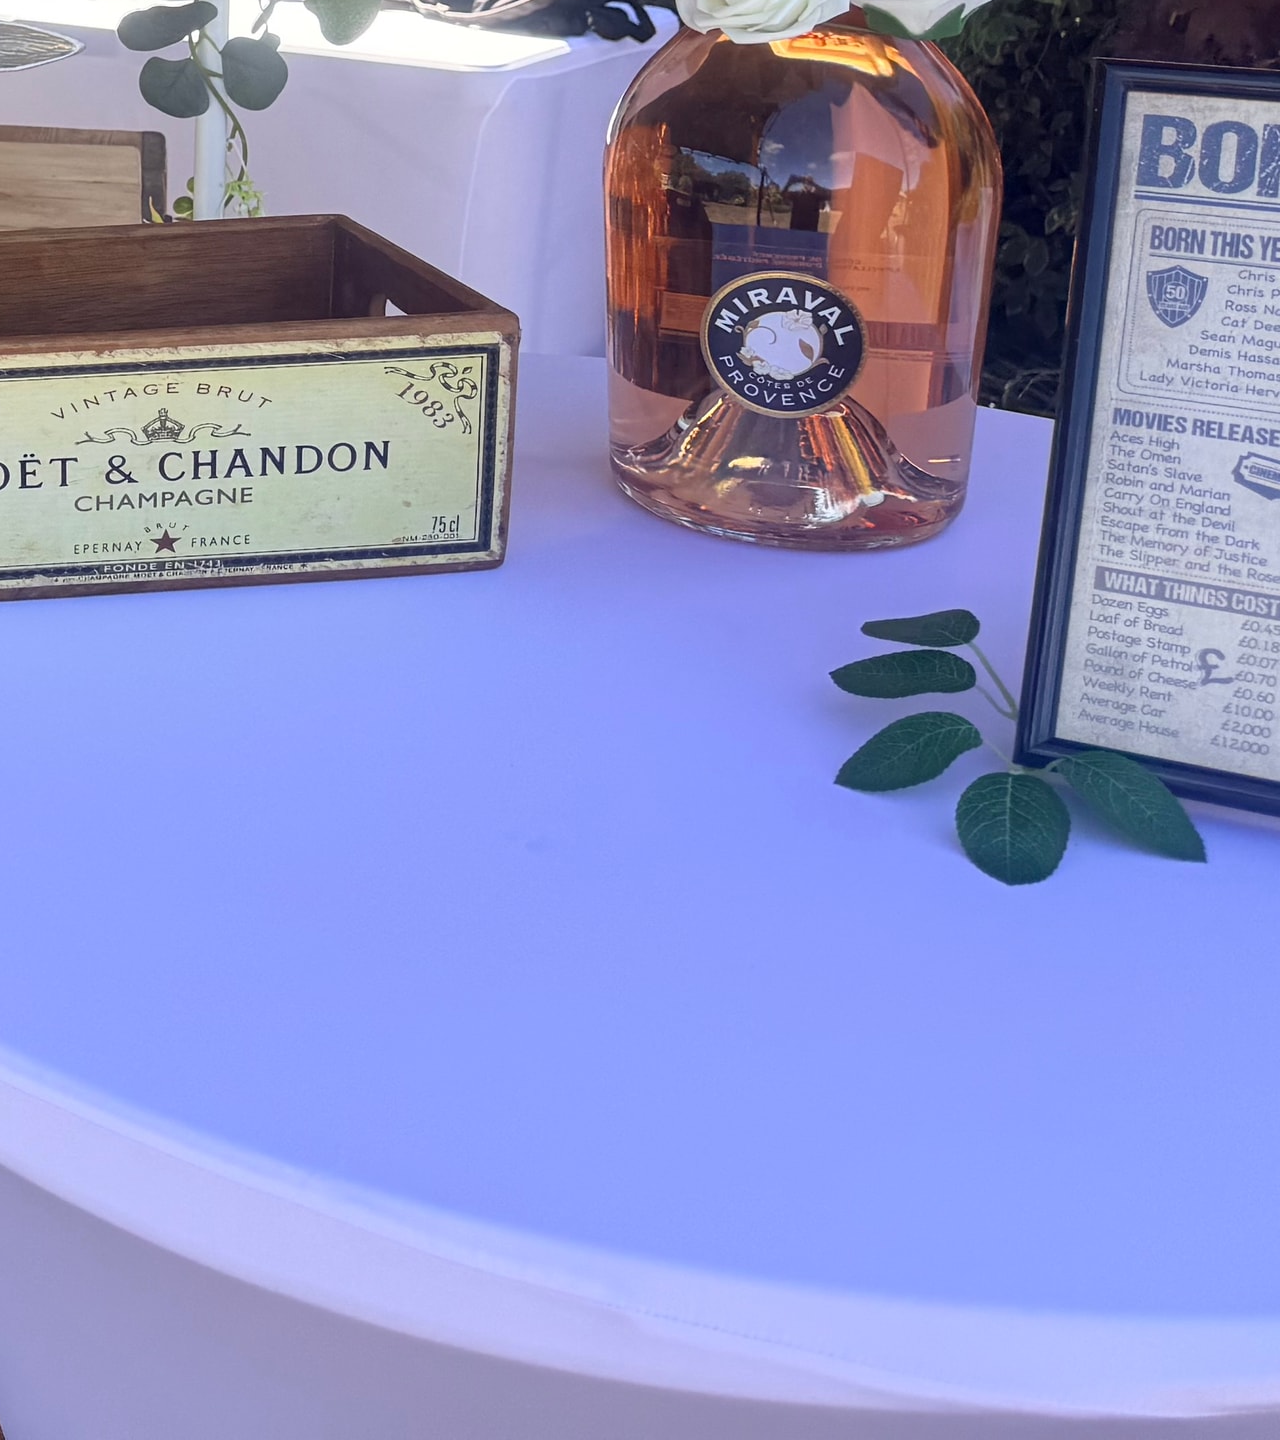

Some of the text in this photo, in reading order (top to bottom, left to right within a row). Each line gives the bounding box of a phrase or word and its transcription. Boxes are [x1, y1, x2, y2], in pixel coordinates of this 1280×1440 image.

[1149, 224, 1207, 256] BORN
[1209, 230, 1255, 260] THIS
[1238, 269, 1276, 283] Chris
[1165, 284, 1186, 300] 50
[1227, 284, 1265, 299] Chris
[714, 286, 855, 347] MIRAVAL
[1224, 299, 1258, 314] Ross
[1220, 316, 1248, 329] Cat
[1200, 330, 1236, 344] Sean
[1188, 344, 1232, 360] Demis
[1166, 357, 1221, 375] Marsha
[718, 355, 846, 406] PROVENCE
[796, 376, 815, 389] DE
[1139, 369, 1175, 387] Lady
[1180, 375, 1239, 394] Victoria
[50, 382, 273, 421] VINTAGE BRUT
[394, 381, 455, 430] 1983
[1112, 407, 1188, 434] MOVIES
[1109, 430, 1181, 453] Aces High
[1110, 444, 1182, 465] The Omen
[104, 454, 139, 485] &
[158, 440, 391, 482] CHANDON
[1107, 459, 1203, 483] Satan's Slave
[74, 486, 254, 512] CHAMPAGNE
[1105, 472, 1231, 502] Robin and Marian
[1103, 487, 1232, 517] Carry On England
[143, 521, 190, 534] BRUT
[431, 514, 460, 533] 75 cl
[1102, 501, 1236, 533] Shout at the Devil
[73, 534, 252, 555] EPERNAY FRANCE
[1101, 515, 1260, 551] Escape from the Dark
[1099, 529, 1268, 567] The Memory of Justice
[104, 561, 160, 573] FONDE
[165, 560, 185, 571] EN
[1097, 543, 1280, 585] The Slipper and the Rose
[1091, 594, 1133, 612] Dozen
[1137, 601, 1169, 620] Eggs
[1104, 571, 1280, 617] WHAT THINGS COST
[1089, 610, 1280, 654] Loaf of Bread £0.18
[1087, 626, 1279, 670] Postage Stamp £0.07
[1085, 642, 1277, 688] Gallon of Petrol £0.70
[1082, 675, 1135, 698] Weekly
[1139, 686, 1174, 702] Rent
[1083, 658, 1276, 704] Pound of Cheese £0.60
[1079, 692, 1137, 714] Average
[1140, 704, 1167, 718] Car
[1077, 708, 1135, 732] Average
[1139, 720, 1180, 739] House
